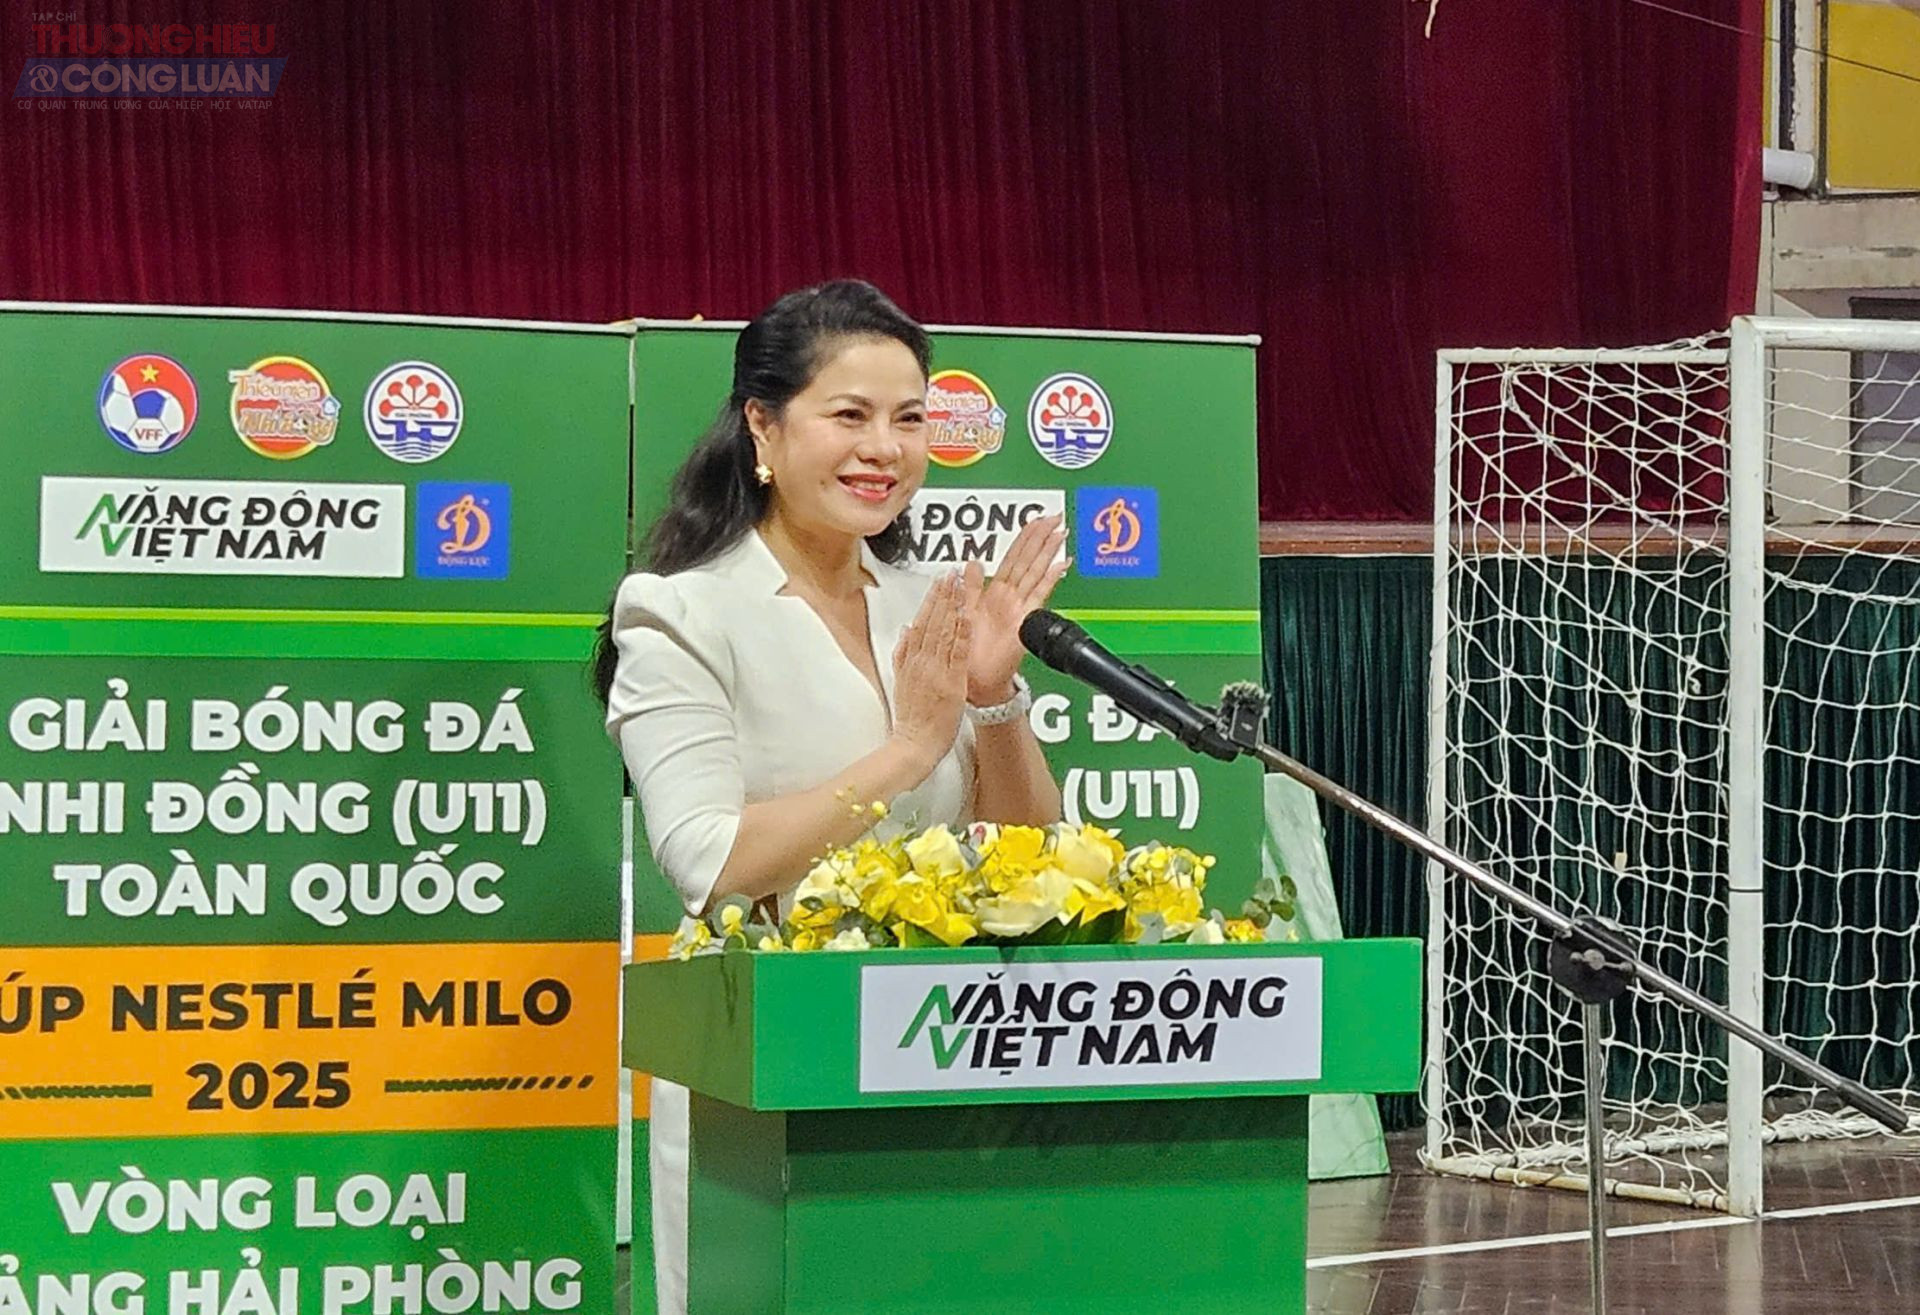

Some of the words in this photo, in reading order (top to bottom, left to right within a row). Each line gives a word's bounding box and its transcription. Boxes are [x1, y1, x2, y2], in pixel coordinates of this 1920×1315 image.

[135, 428, 163, 440] VFF
[75, 487, 231, 539] NĂNG
[100, 519, 209, 562] VIỆT
[216, 529, 326, 560] NAM
[9, 678, 166, 752] GIẢI
[191, 685, 404, 752] BÓNG
[424, 688, 535, 753] ĐÁ
[0, 781, 125, 833] NHI
[146, 762, 370, 834] ĐỒNG
[393, 779, 547, 846] (U11)
[1063, 767, 1200, 830] (U11)
[53, 849, 266, 917] TOÀN
[290, 843, 504, 926] QUỐC
[111, 967, 376, 1031] NESTLÉ
[402, 978, 572, 1026] MILO
[898, 972, 1097, 1048] NĂNG
[929, 1014, 1070, 1076] VIỆT
[1077, 1023, 1218, 1065] NAM
[185, 1061, 351, 1111] 2025
[52, 1165, 272, 1234] VÒNG
[295, 1172, 467, 1240] LOẠI
[169, 1246, 299, 1315] HẢI
[324, 1247, 582, 1315] PHÒNG
